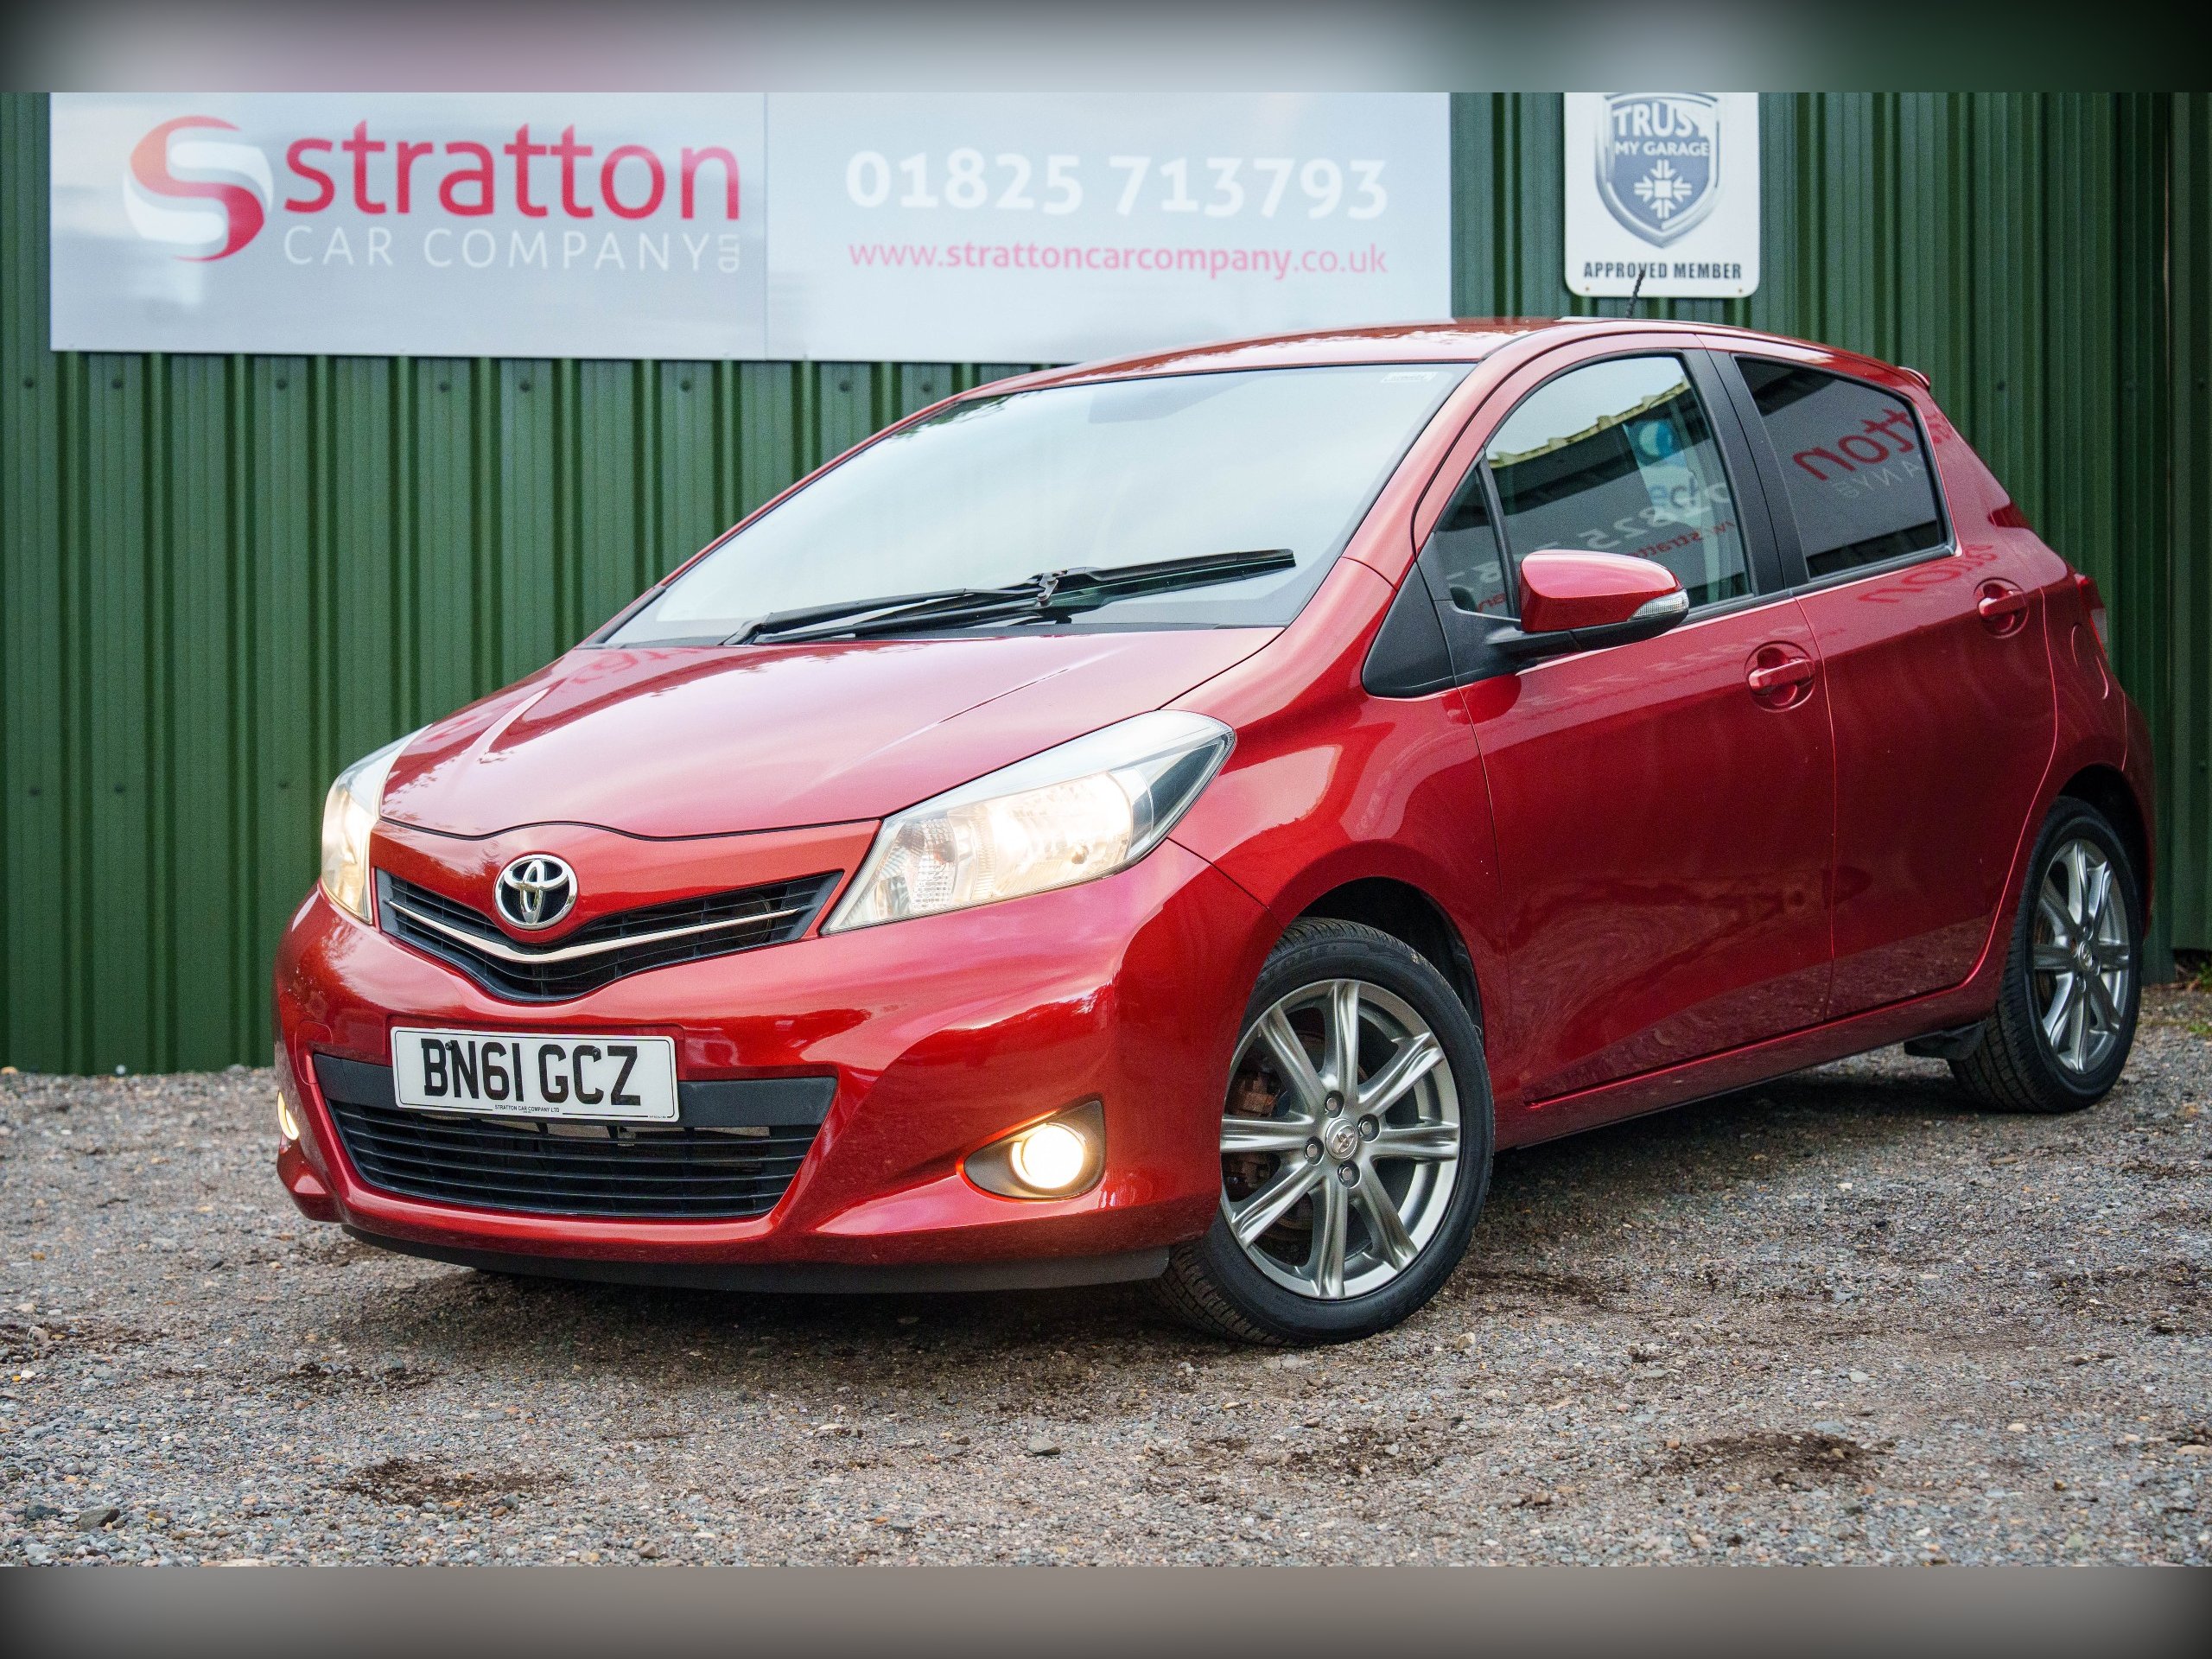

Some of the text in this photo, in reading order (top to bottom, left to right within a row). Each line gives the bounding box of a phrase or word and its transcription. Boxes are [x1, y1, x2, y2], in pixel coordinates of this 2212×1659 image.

[1612, 101, 1710, 138] TRUS
[283, 119, 741, 220] stratton
[1615, 141, 1710, 157] MY GARAGE
[846, 147, 1389, 220] 01825 713793
[283, 225, 710, 272] CAR COMPANY
[717, 232, 740, 274] LTD
[848, 241, 1389, 281] www.strattoncarcompany.co.uk
[1584, 262, 1742, 279] APPROVED MEMBER
[421, 1038, 641, 1106] BN61 GCZ
